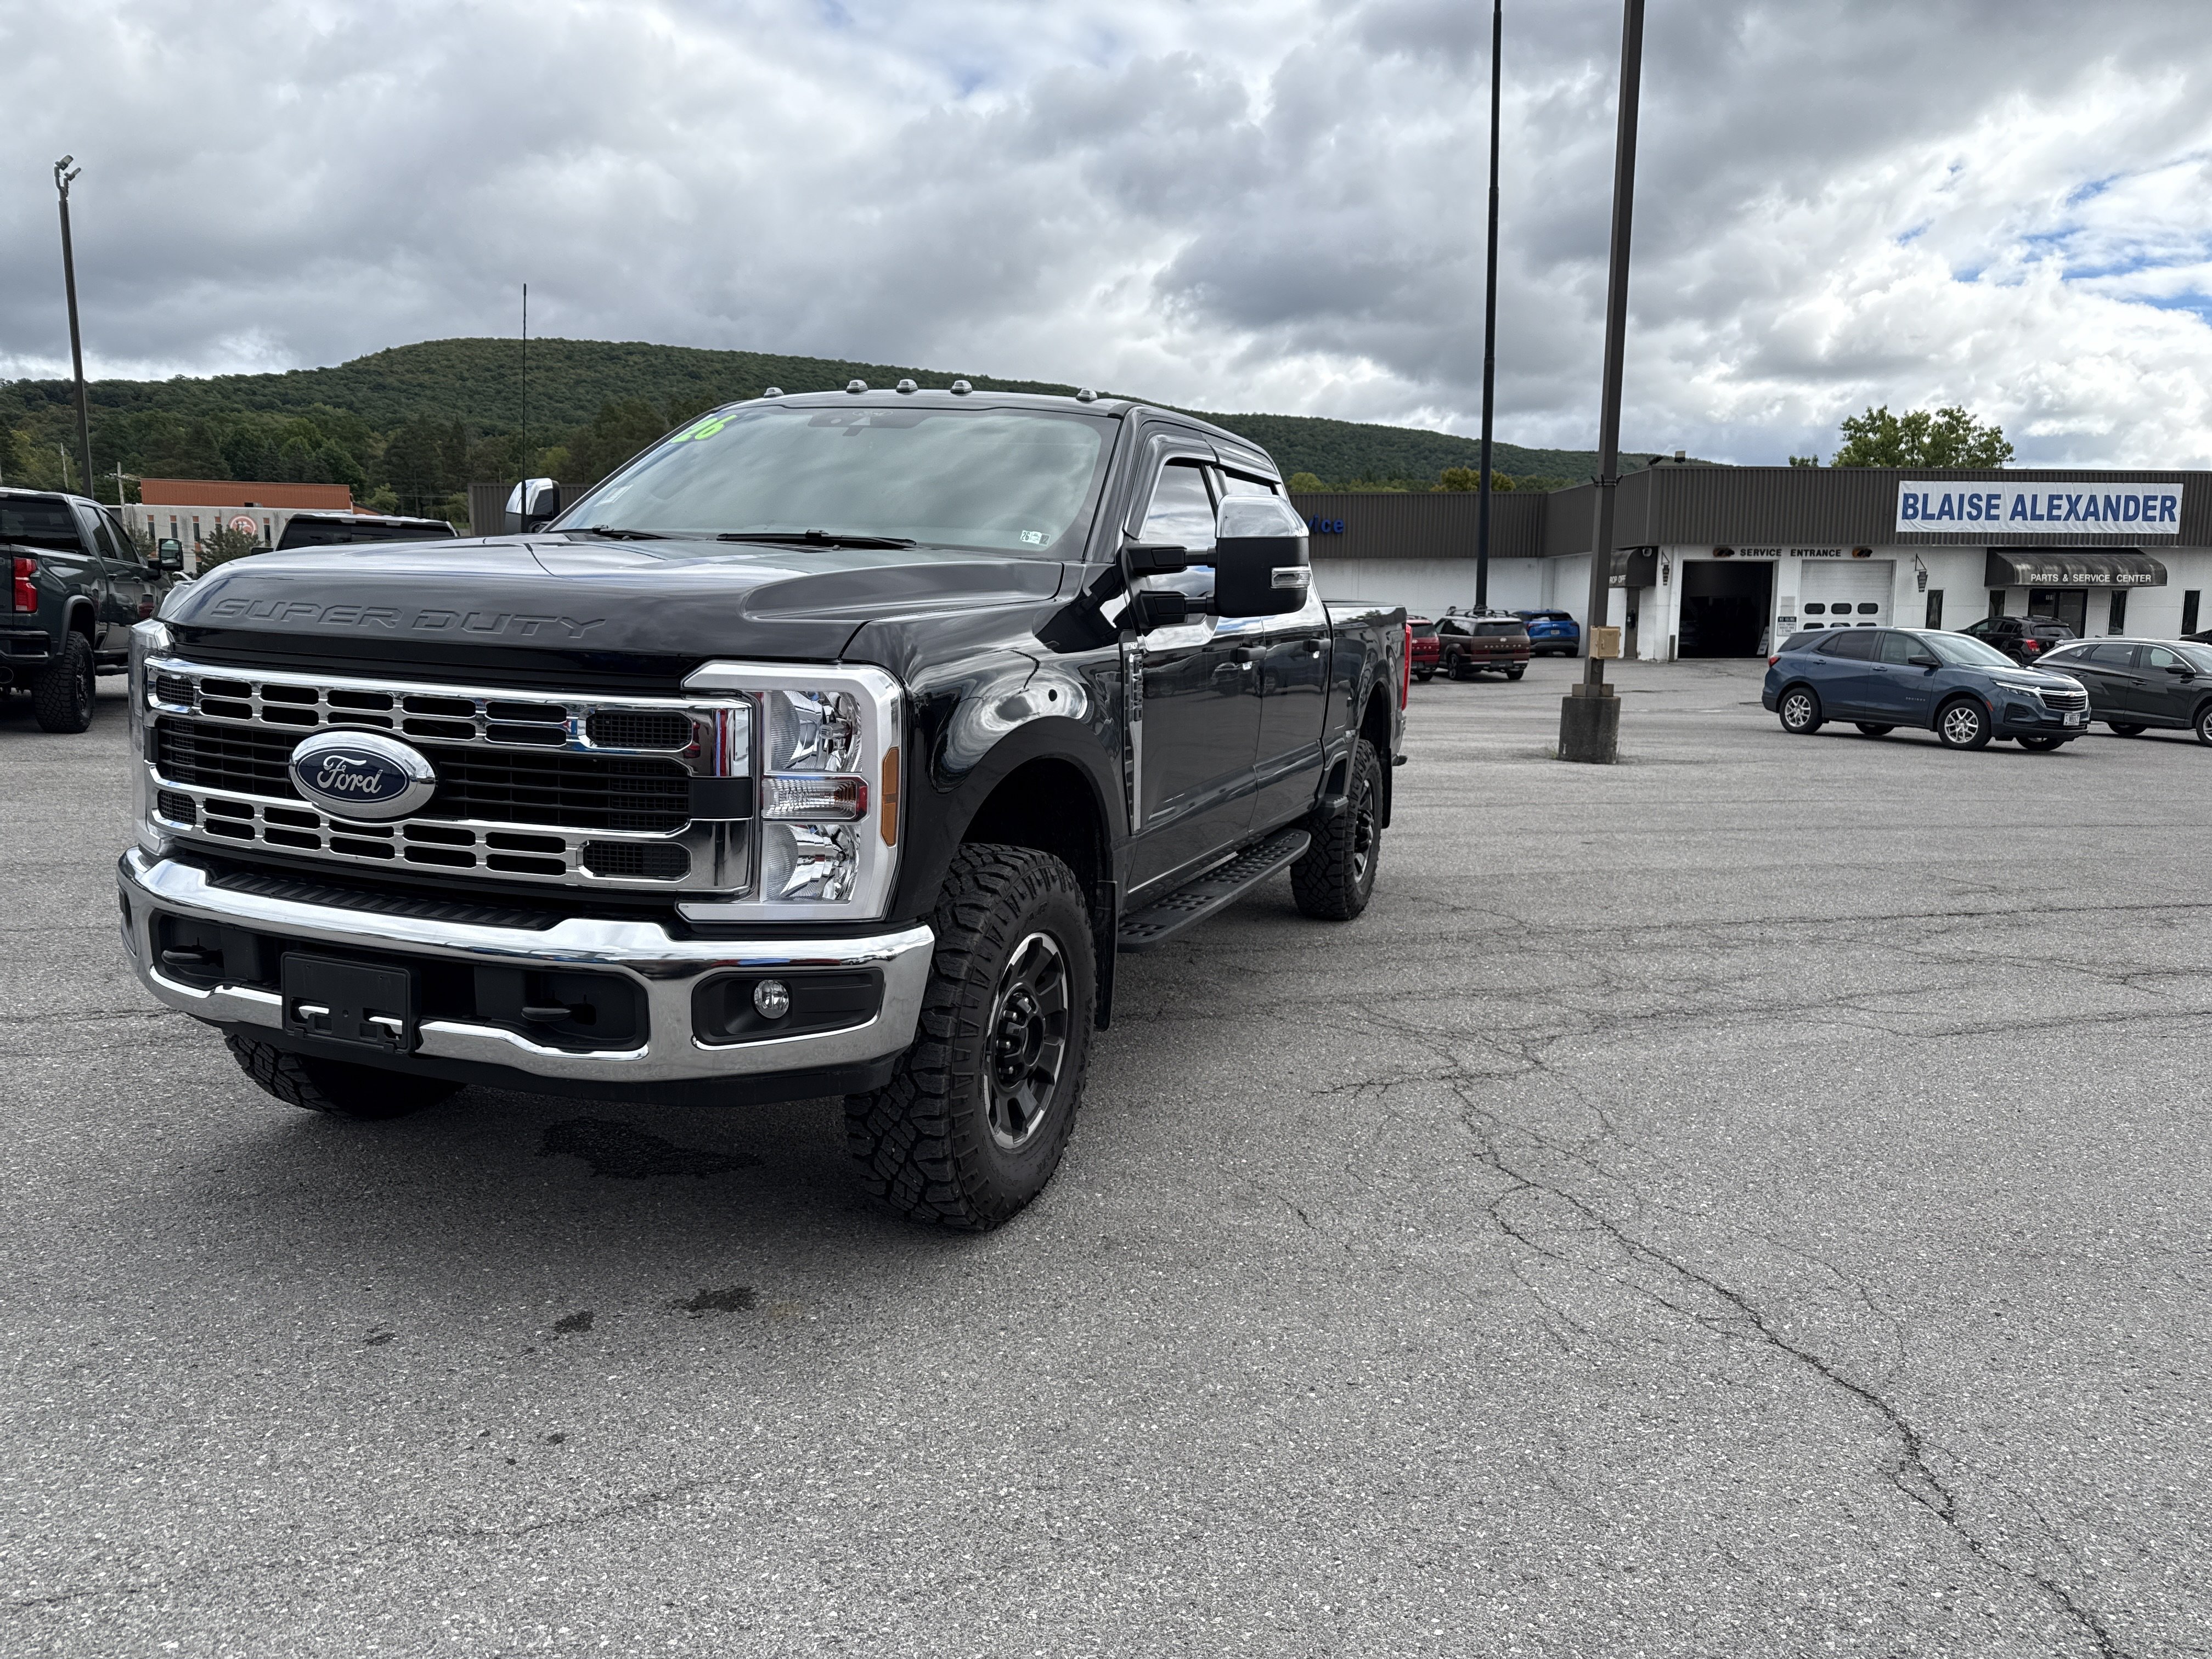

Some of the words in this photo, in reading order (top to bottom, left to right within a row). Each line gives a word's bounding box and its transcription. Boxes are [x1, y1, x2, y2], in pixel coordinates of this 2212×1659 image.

[670, 415, 737, 443] 26
[1901, 493, 2001, 521] BLAISE
[2009, 494, 2177, 522] ALEXANDER
[1022, 531, 1030, 541] 26
[1740, 548, 1782, 557] SERVICE
[1790, 548, 1842, 557] ENTRANCE
[2030, 573, 2059, 582] PARTS
[2062, 574, 2069, 582] &
[2073, 574, 2111, 583] SERVICE
[2116, 574, 2152, 583] CENTER
[211, 598, 403, 628] SUPER
[411, 610, 606, 639] DUTY
[317, 755, 383, 794] Ford
